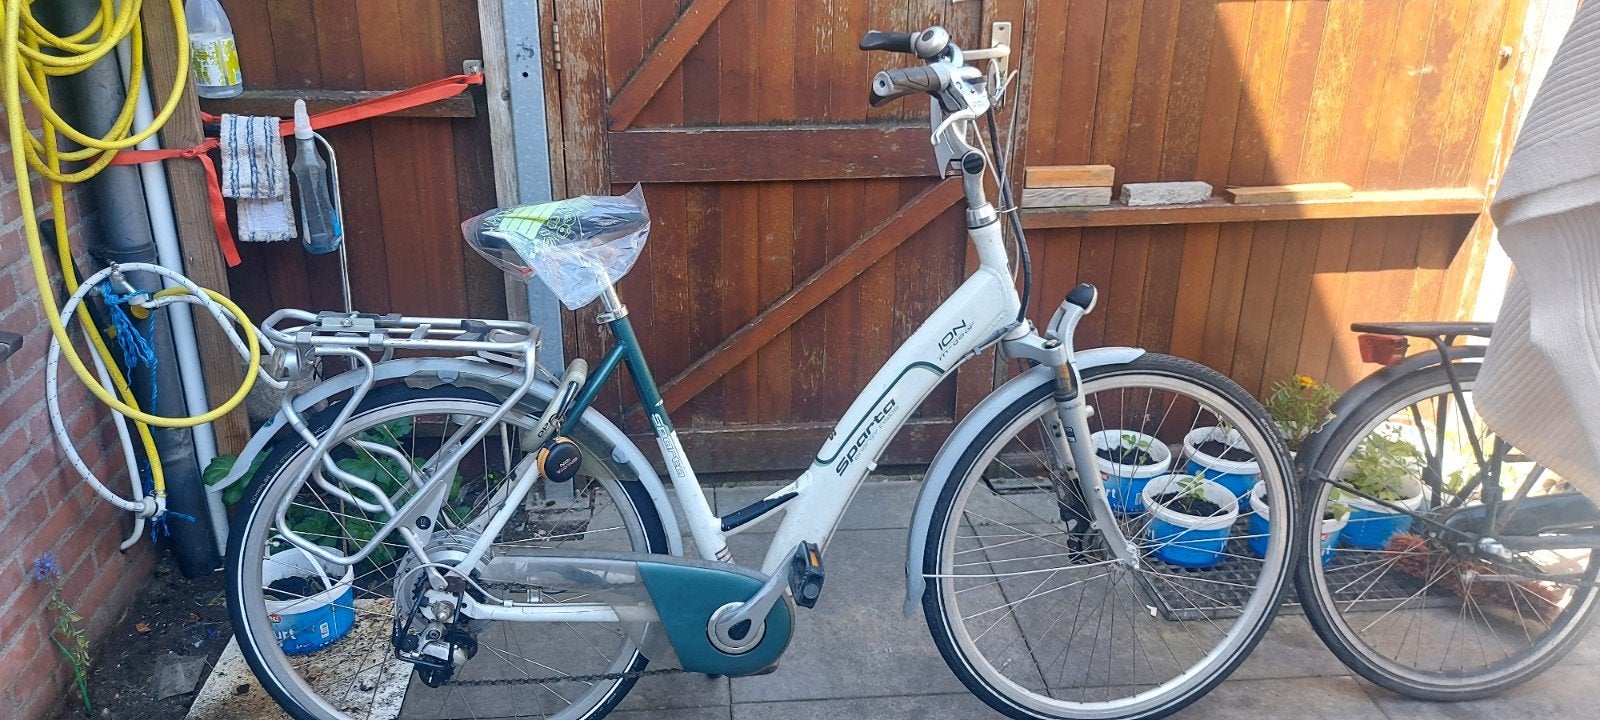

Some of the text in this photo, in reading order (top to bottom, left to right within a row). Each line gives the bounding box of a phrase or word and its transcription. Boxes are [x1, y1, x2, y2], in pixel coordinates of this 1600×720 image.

[938, 319, 966, 351] ION
[651, 413, 686, 478] Sparta
[836, 399, 896, 477] Sparta
